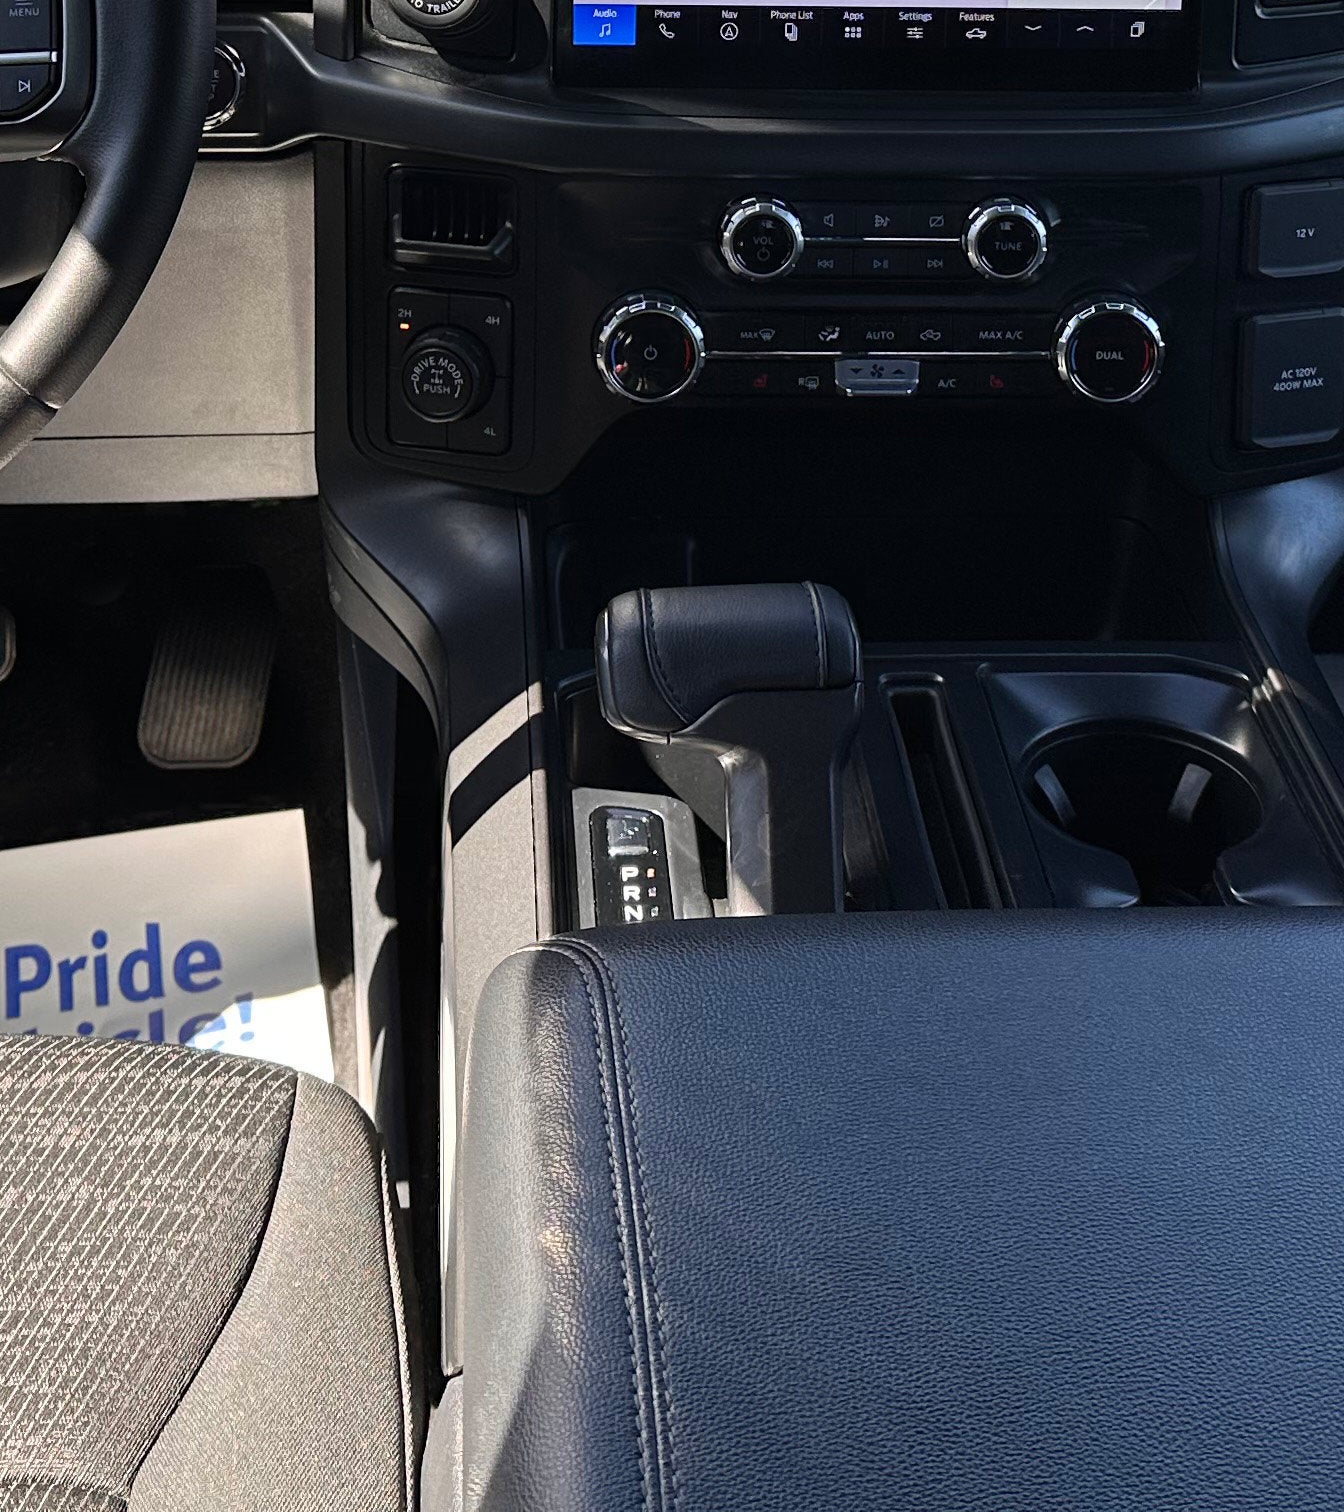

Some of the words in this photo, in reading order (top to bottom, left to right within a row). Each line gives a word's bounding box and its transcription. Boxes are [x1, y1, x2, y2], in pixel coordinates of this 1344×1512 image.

[9, 7, 40, 18] MENU
[593, 8, 617, 19] Audio
[654, 9, 681, 20] Phone
[721, 9, 739, 20] Nav
[770, 10, 796, 20] Phone
[797, 10, 814, 20] List
[843, 10, 865, 23] Apps
[898, 11, 933, 24] Settings
[959, 11, 995, 22] Features
[1296, 228, 1306, 238] 12
[1306, 227, 1315, 237] V
[753, 236, 774, 245] VOL
[994, 241, 1023, 251] TUNE
[397, 308, 412, 318] 2H
[484, 316, 500, 326] 4H
[865, 331, 895, 340] AUTO
[978, 331, 1003, 340] MAX
[1005, 330, 1023, 340] A/C
[1095, 350, 1124, 361] DUAL
[411, 356, 436, 381] DRIVE
[438, 357, 464, 385] MODE
[1281, 369, 1294, 379] AC
[1295, 367, 1318, 378] 120V
[937, 378, 956, 388] A/C
[1302, 377, 1324, 389] MAX
[423, 384, 451, 394] PUSH
[484, 427, 496, 436] 4L
[620, 866, 640, 882] P
[623, 885, 641, 902] R
[624, 904, 644, 922] N
[4, 922, 222, 1019] Pride
